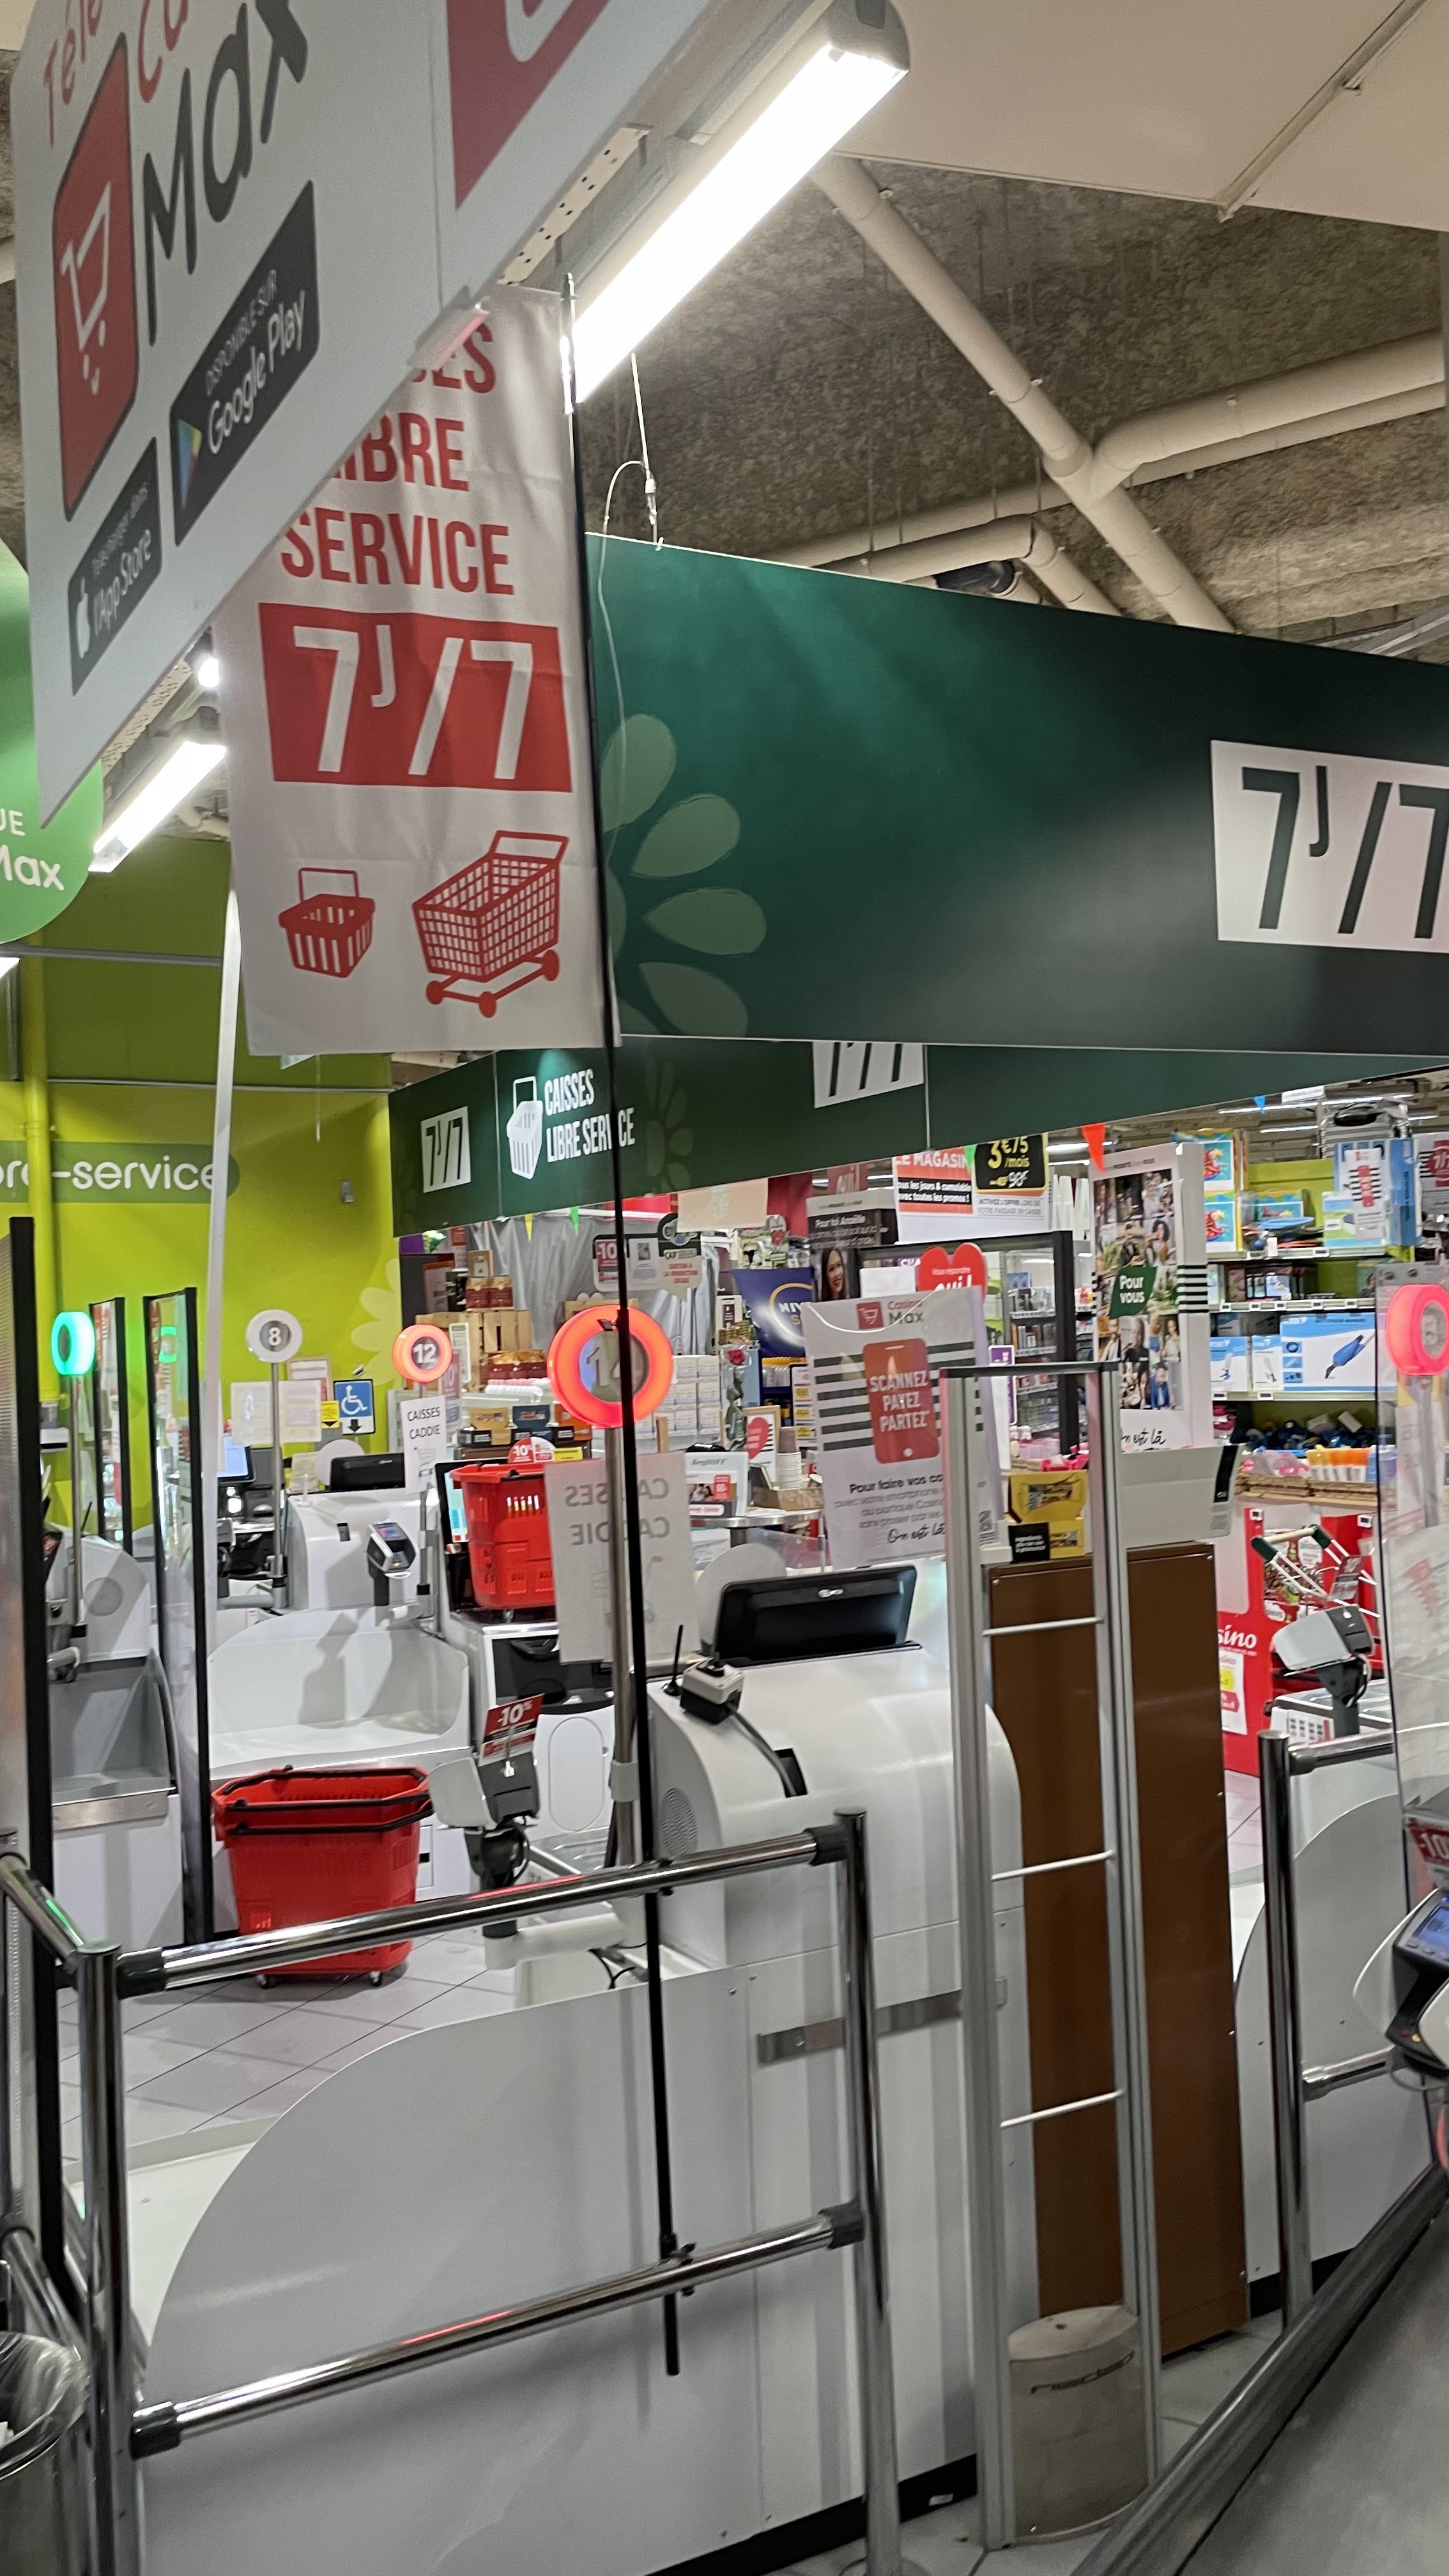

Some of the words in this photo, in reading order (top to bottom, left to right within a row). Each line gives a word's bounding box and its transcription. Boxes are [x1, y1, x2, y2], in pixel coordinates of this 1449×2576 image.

[208, 346, 266, 454] Google
[267, 289, 305, 372] Play
[332, 412, 470, 492] BRE
[280, 507, 515, 595] SERVICE
[120, 529, 151, 595] Store
[544, 1068, 595, 1116] CAISSES
[546, 1120, 581, 1163] LIBRE
[582, 1107, 636, 1156] SERCE
[1119, 1275, 1144, 1289] Pour
[1119, 1291, 1146, 1303] vous
[889, 1311, 924, 1325] Max
[268, 1327, 281, 1346] 8
[412, 1343, 437, 1364] 12
[869, 1370, 930, 1393] SCANNEZ
[882, 1392, 921, 1411] PAYEZ
[407, 1406, 441, 1422] CAISSES
[879, 1411, 930, 1432] PARTEZ
[409, 1424, 441, 1439] CADDIE
[849, 1483, 876, 1494] Pour
[878, 1478, 904, 1490] faire
[907, 1476, 926, 1486] vos
[887, 1528, 908, 1544] On
